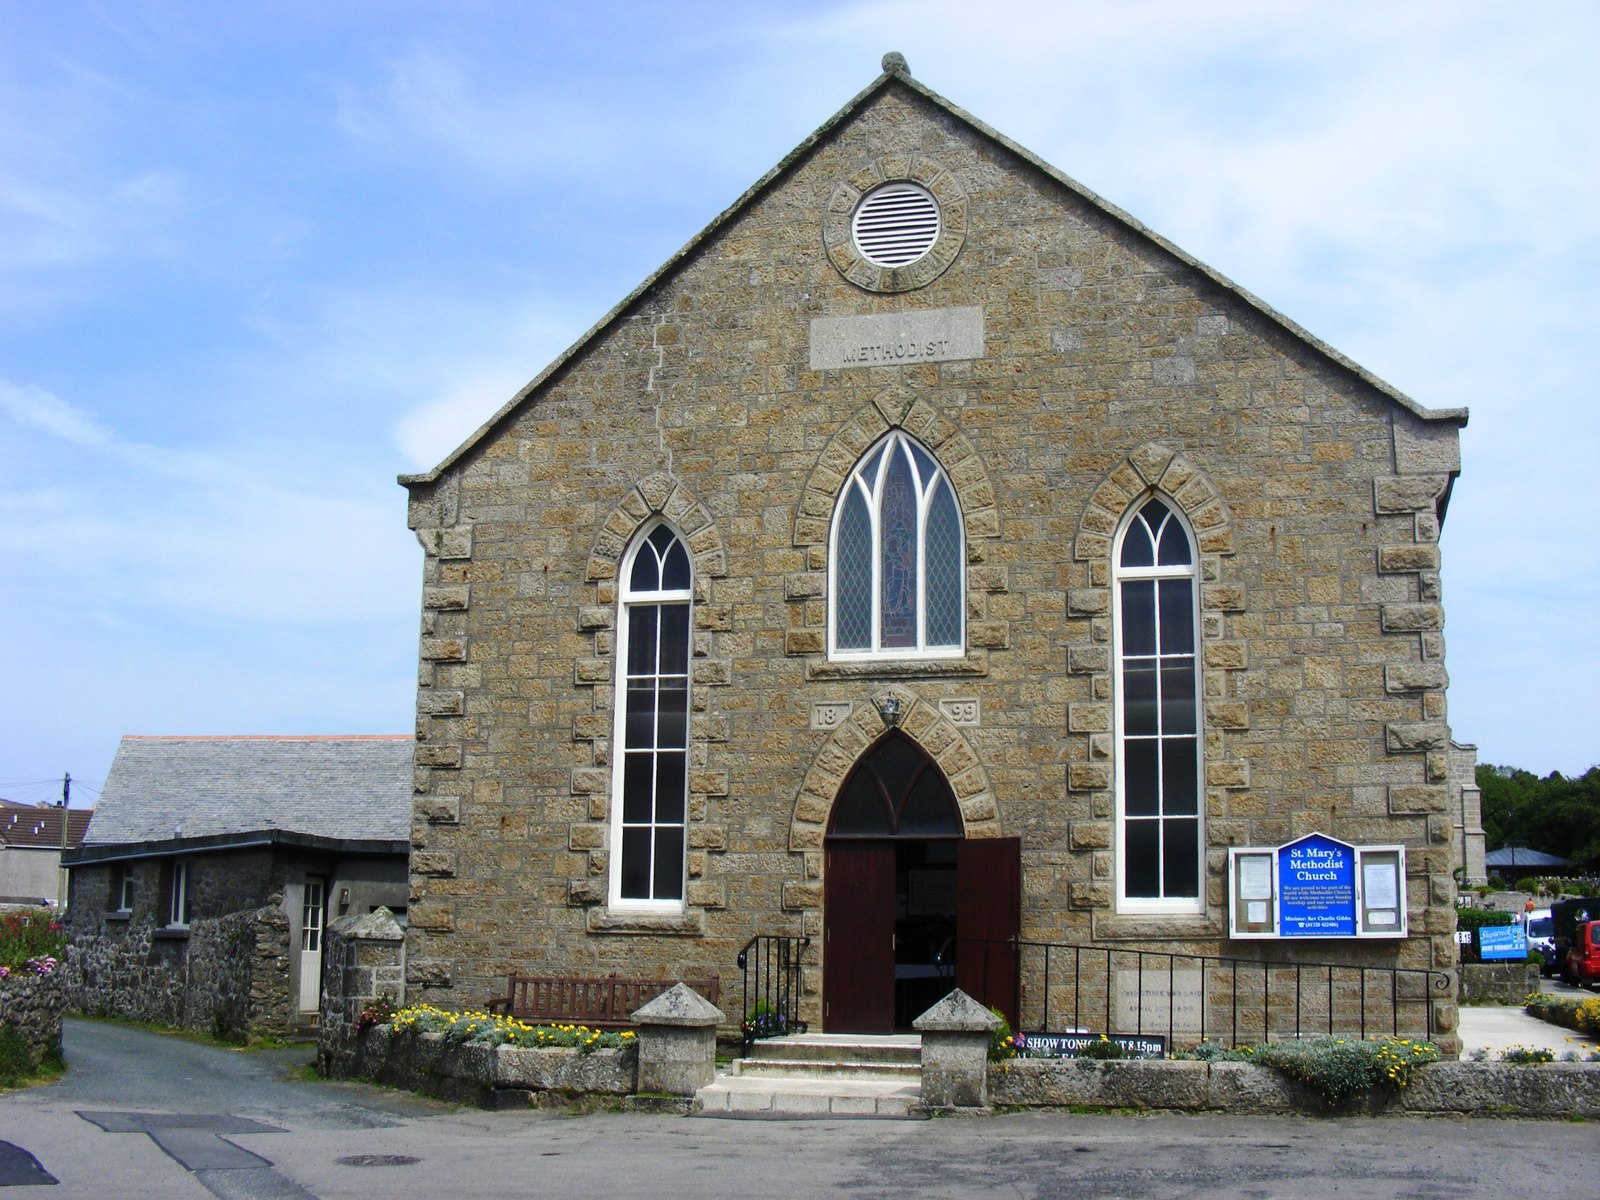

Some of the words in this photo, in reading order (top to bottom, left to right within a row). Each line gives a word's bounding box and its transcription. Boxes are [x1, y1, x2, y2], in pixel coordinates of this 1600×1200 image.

[843, 341, 948, 363] METHODIST
[817, 709, 836, 725] 18
[951, 704, 974, 721] 99
[1291, 848, 1304, 858] St.
[1306, 848, 1342, 860] Mary's
[1290, 860, 1343, 870] Methodist
[1296, 871, 1337, 881] Church
[1026, 1039, 1059, 1050] SHOW
